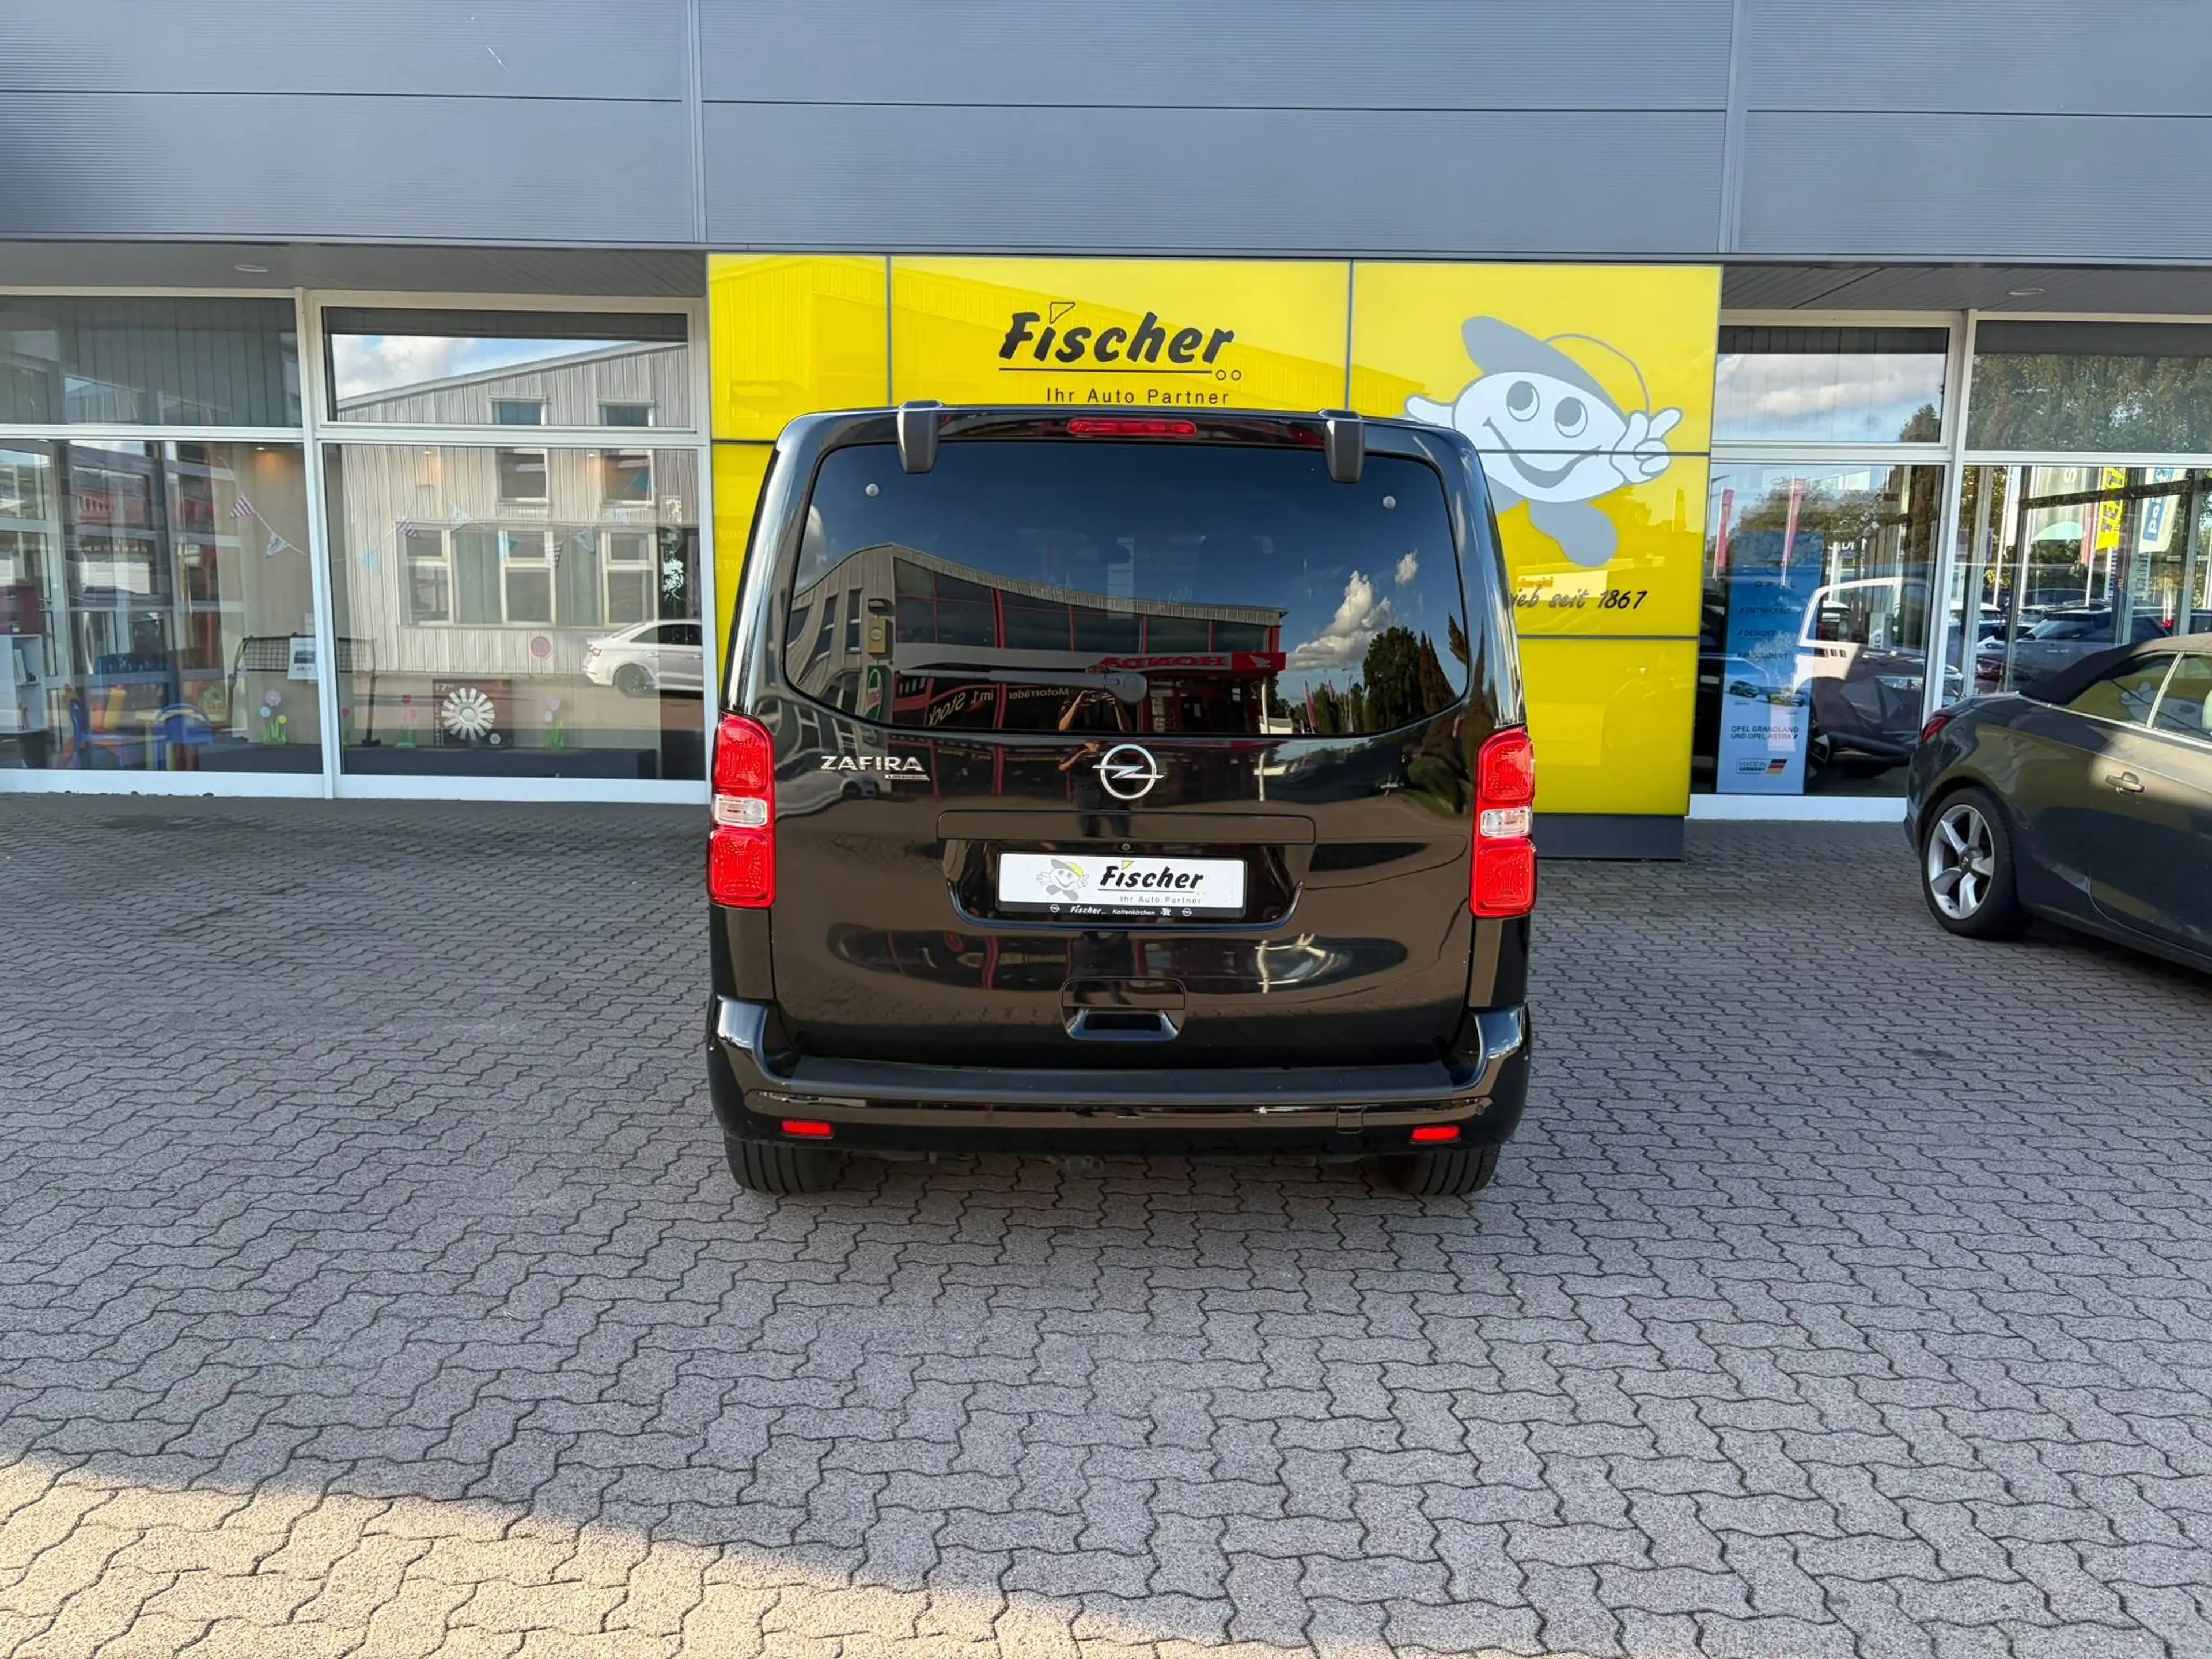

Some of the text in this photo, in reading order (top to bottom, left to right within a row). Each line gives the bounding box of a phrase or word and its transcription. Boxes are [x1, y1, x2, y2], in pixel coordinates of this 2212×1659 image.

[999, 302, 1234, 364] Fischer
[1047, 388, 1229, 404] Ihr Auto Partner
[1598, 589, 1647, 609] 1867
[820, 756, 925, 771] ZAFIRA
[1100, 861, 1203, 889] Fischer
[1120, 895, 1202, 905] Ihr Auto Partner
